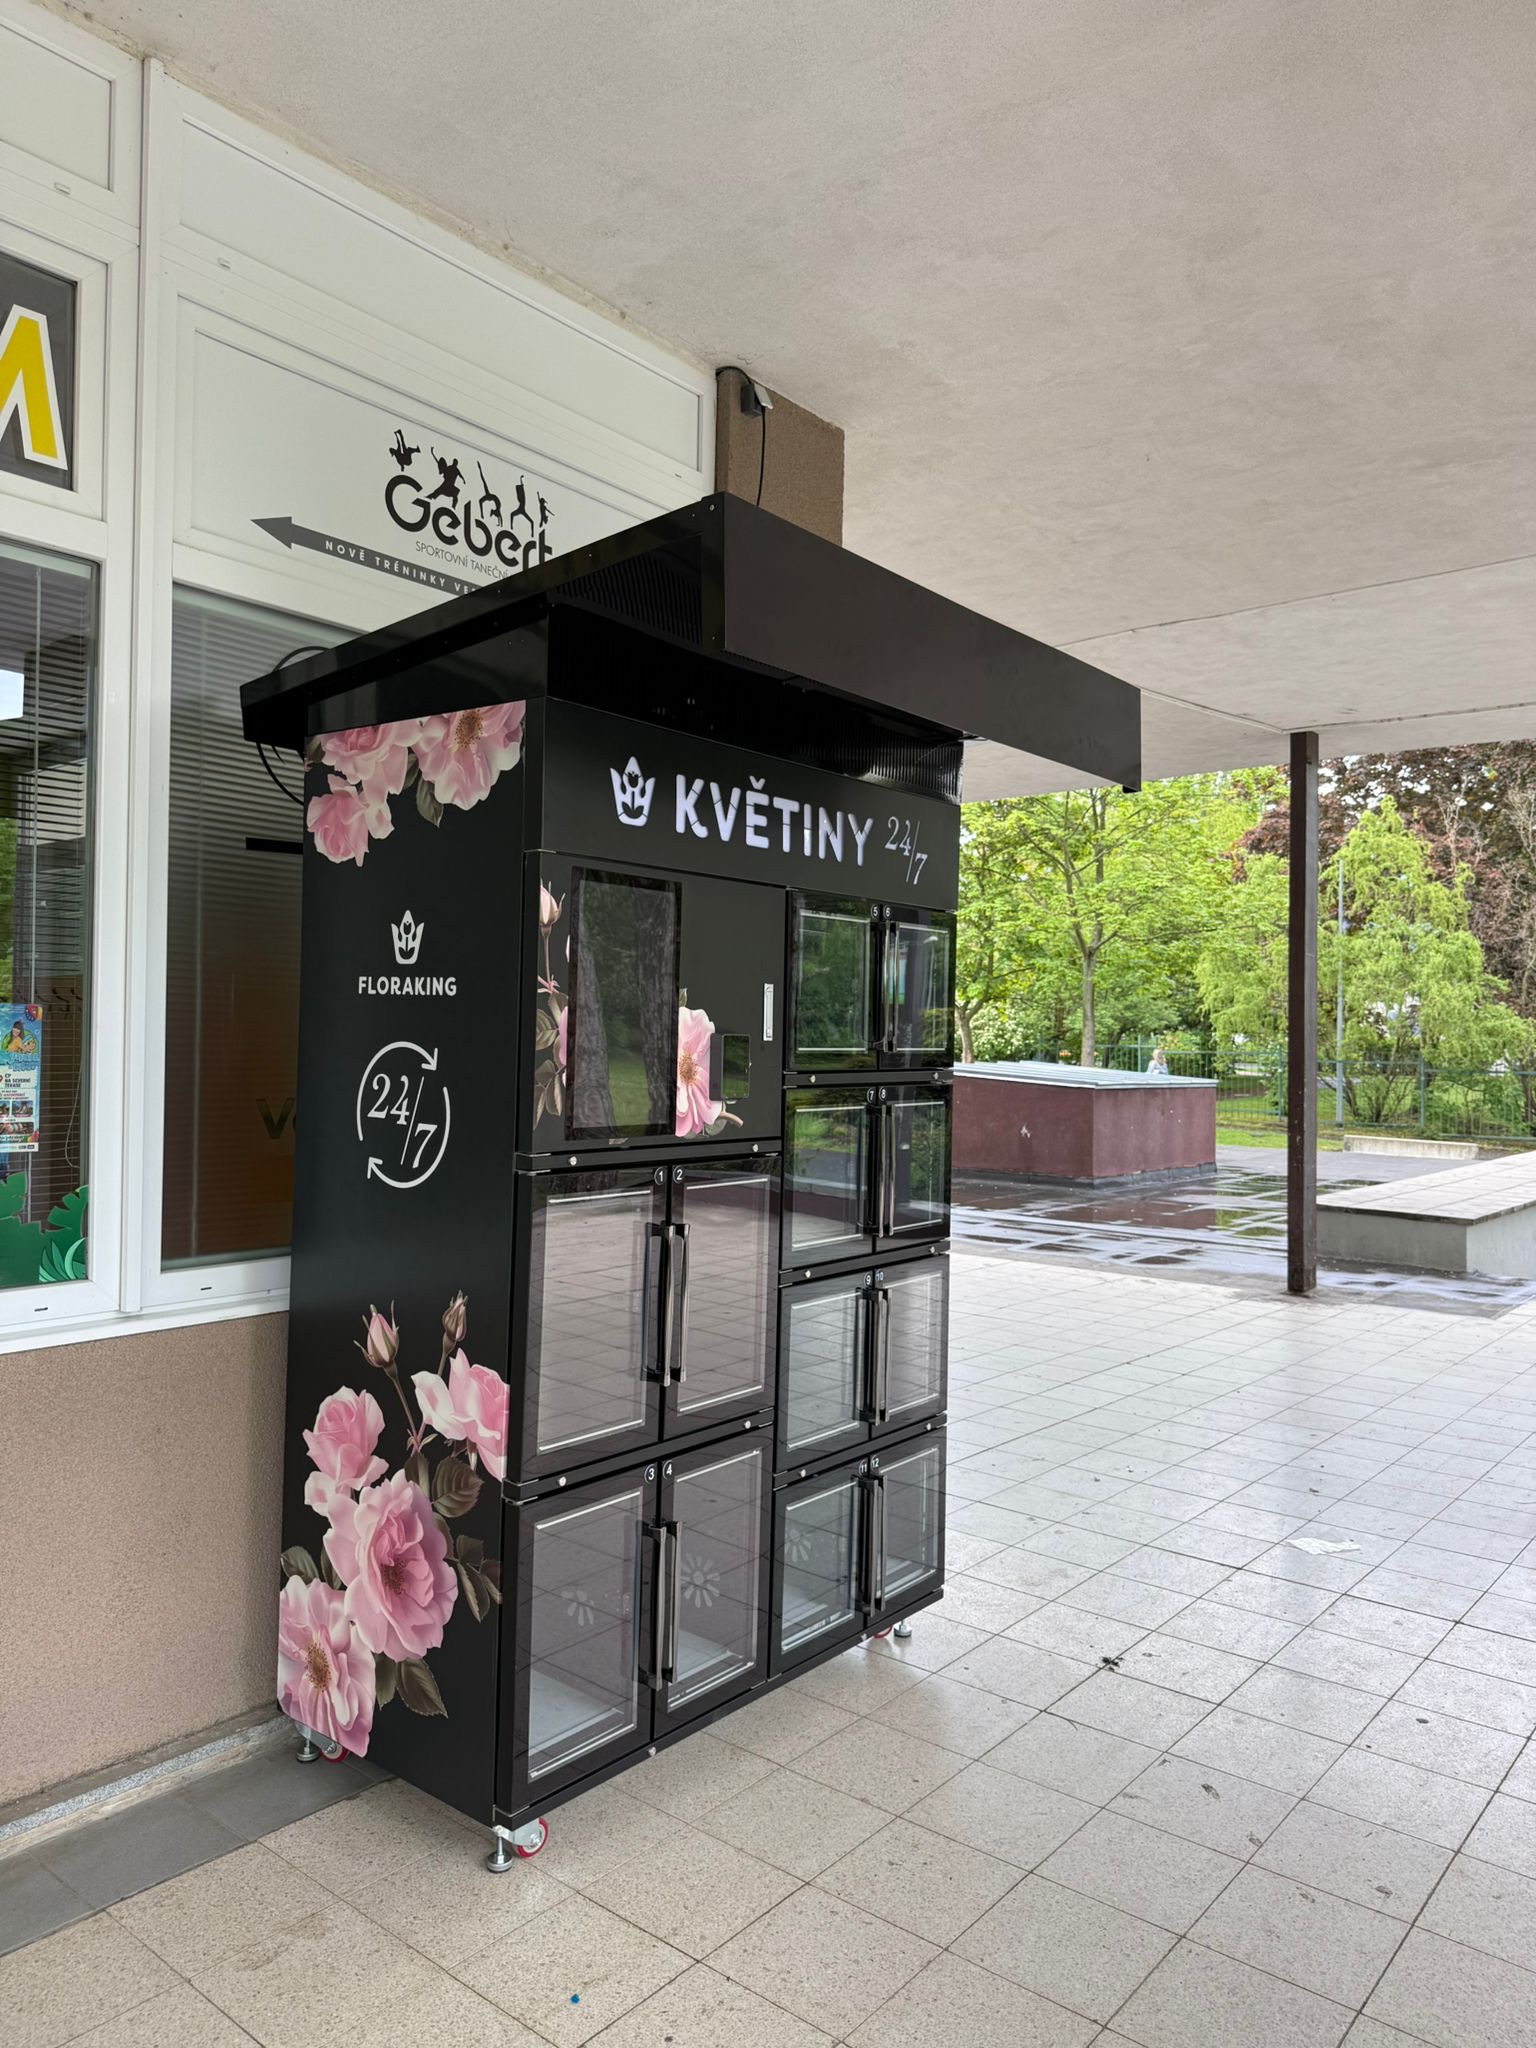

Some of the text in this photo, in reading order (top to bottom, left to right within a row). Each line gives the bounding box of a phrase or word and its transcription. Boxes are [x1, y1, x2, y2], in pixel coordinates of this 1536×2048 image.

[384, 474, 553, 571] Gebert
[415, 541, 469, 568] SPORTOVNÍ
[374, 556, 446, 588] TRÉNINKY
[675, 773, 929, 886] KVĚTINY 24/7
[358, 975, 458, 997] FLORAKING
[366, 1072, 438, 1169] 24/7
[676, 1168, 683, 1181] 2
[648, 1467, 655, 1481] 3
[666, 1463, 673, 1476] 4
[872, 1457, 879, 1468] 12
